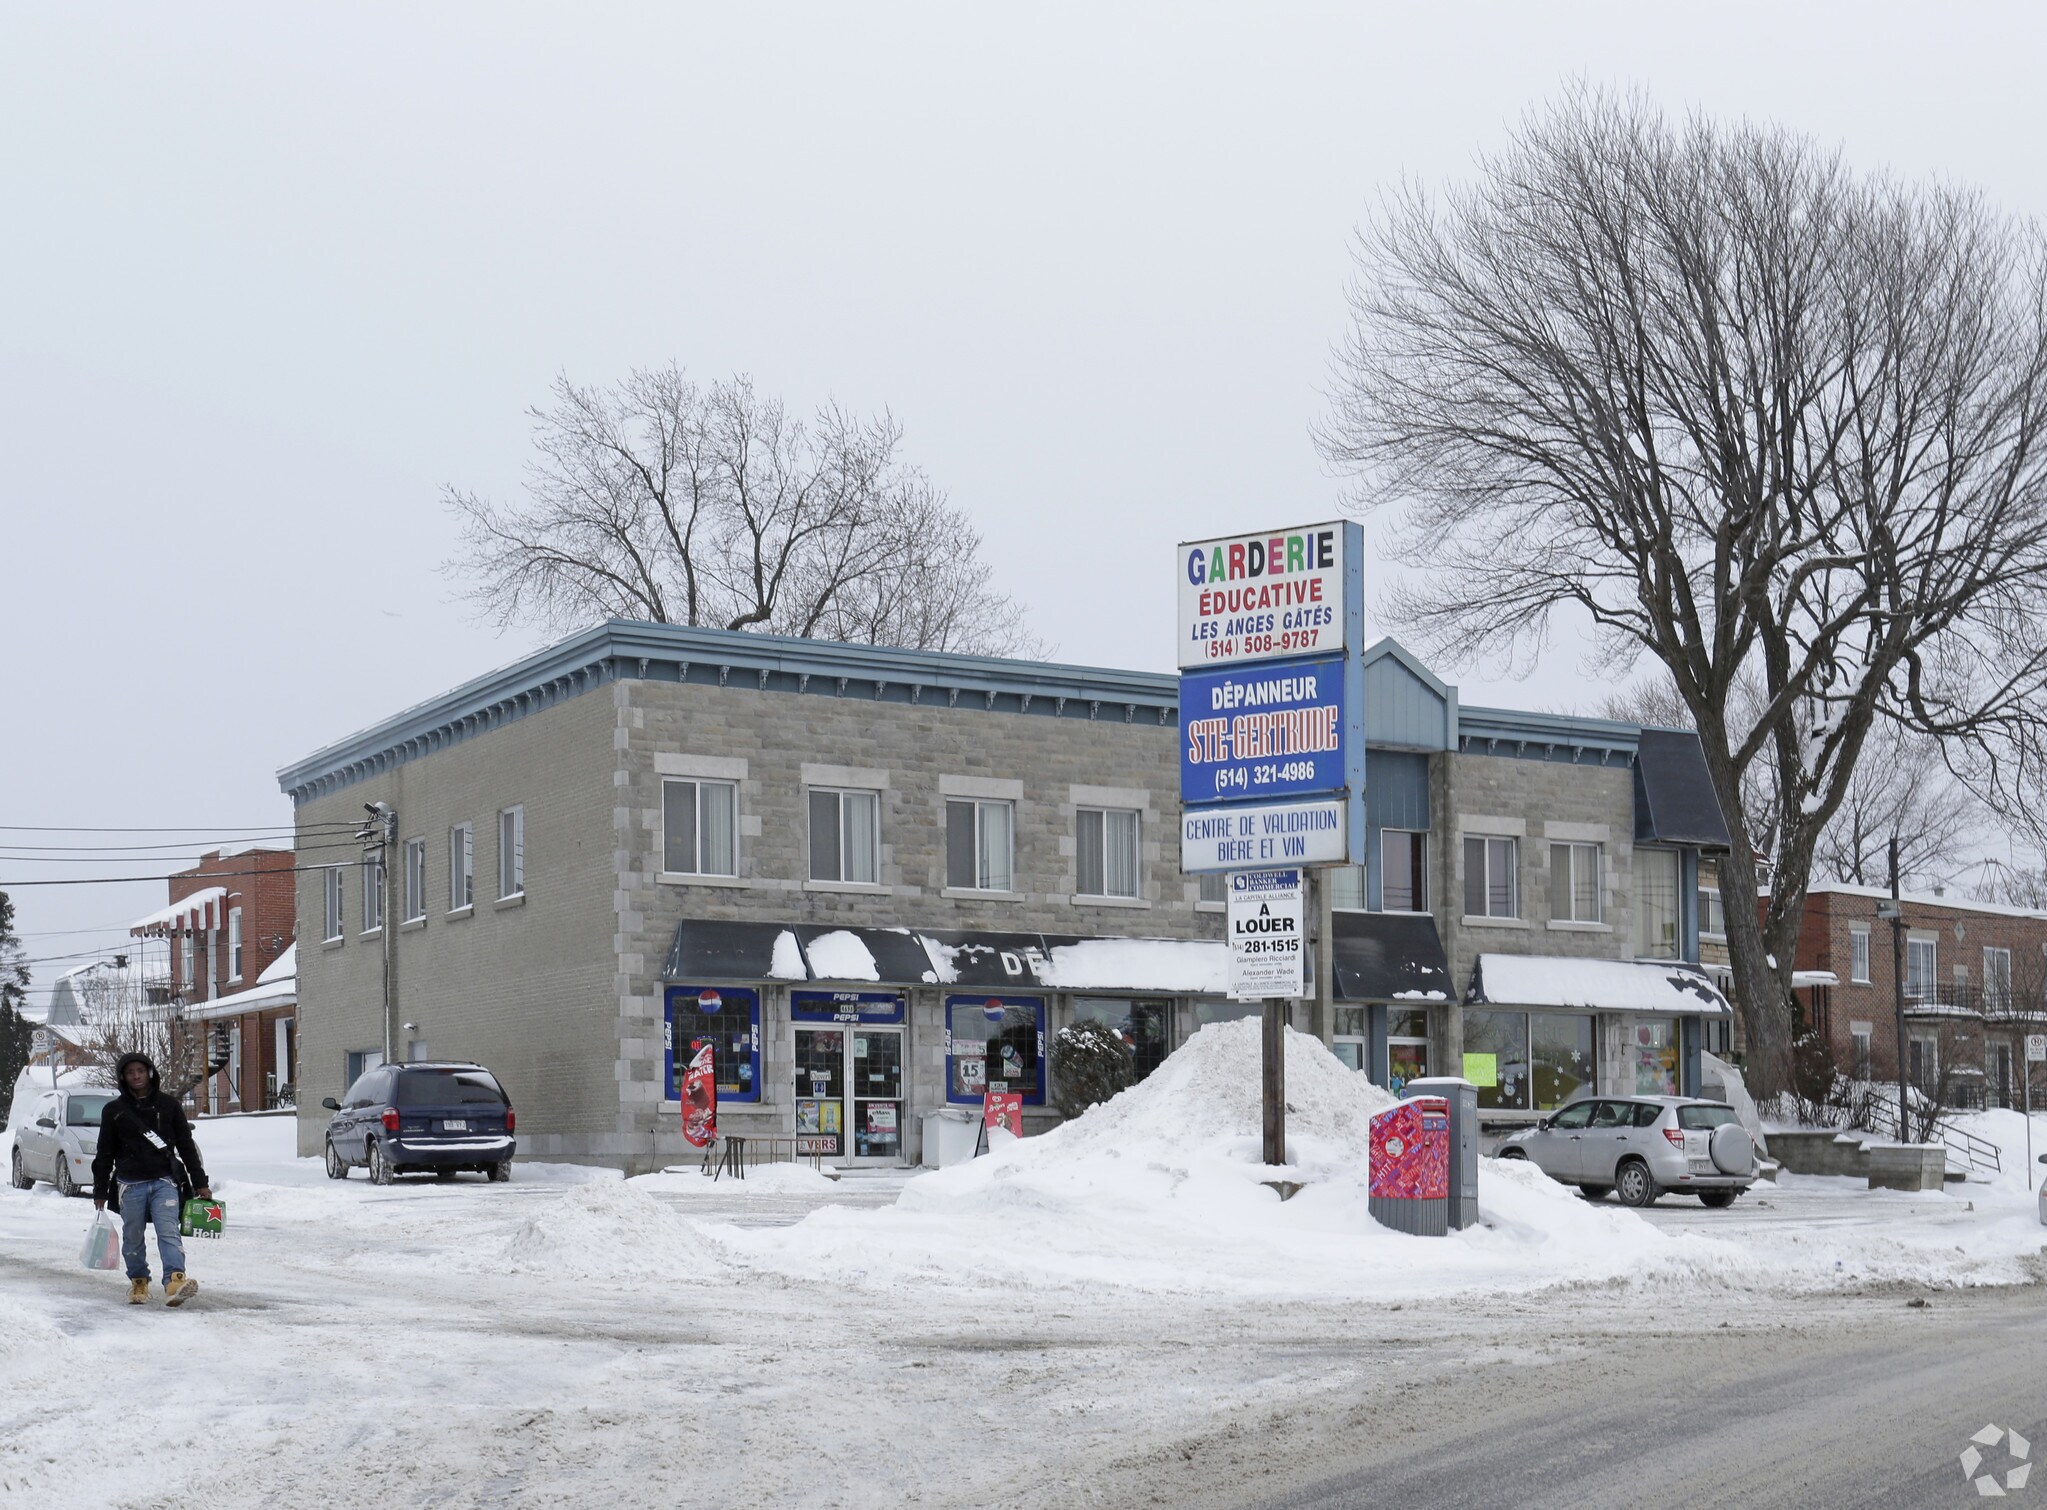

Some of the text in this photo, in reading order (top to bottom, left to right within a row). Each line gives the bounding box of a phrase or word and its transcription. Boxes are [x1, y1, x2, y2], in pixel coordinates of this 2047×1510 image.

[1187, 531, 1334, 586] GARDERIE
[1199, 578, 1323, 616] ÉDUCATIVE
[1191, 605, 1332, 641] LES ANGES GÂTÉS
[1205, 629, 1319, 659] (514) 508-9787
[1211, 676, 1318, 710] DÉPANNEUR
[1188, 705, 1339, 764] STE-GERTRUDE
[1215, 761, 1315, 792] (514) 321-4986
[1186, 810, 1337, 840] CENTRE DE VALIDATION
[1218, 836, 1305, 862] BIÈRE ET VIN
[1236, 917, 1295, 934] LOUER
[1244, 939, 1299, 954] 281-1515
[1242, 969, 1275, 977] Alexander
[833, 993, 859, 1001] PEPSI
[833, 1014, 860, 1022] PEPSI
[751, 1024, 759, 1053] PEPSI
[962, 1065, 979, 1077] 15
